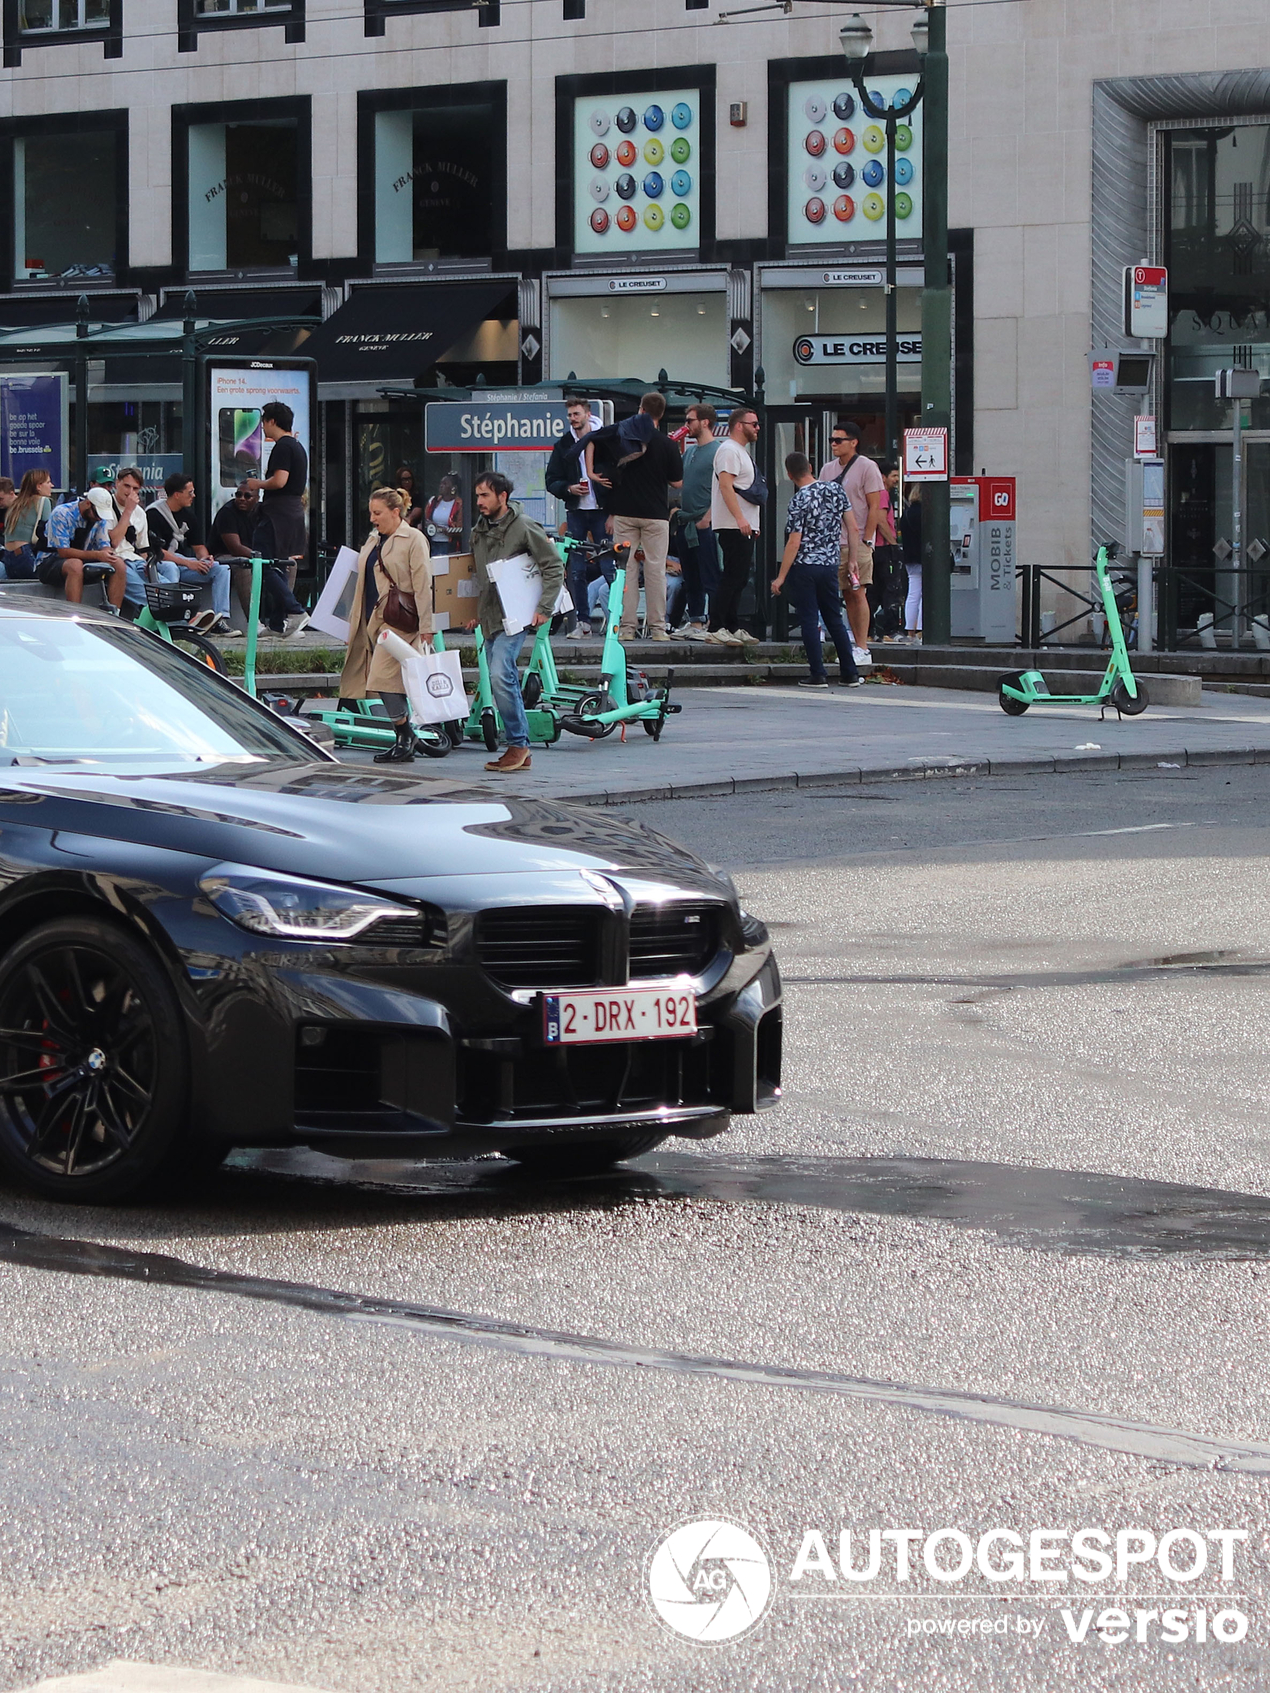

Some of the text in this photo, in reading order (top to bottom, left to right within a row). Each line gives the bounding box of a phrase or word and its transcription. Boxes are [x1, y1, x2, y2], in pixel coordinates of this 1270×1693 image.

[437, 161, 478, 188] MULLER
[843, 273, 877, 281] CREUSET
[618, 280, 662, 289] LE CREUSET
[208, 337, 240, 345] LLER
[335, 332, 433, 344] FRANCK MULLER
[822, 341, 922, 356] LE CRESE
[217, 377, 237, 385] iPhone
[217, 386, 229, 394] Een
[229, 387, 245, 395] grote
[246, 387, 266, 396] sprong
[487, 392, 518, 402] Stéphanie
[522, 392, 548, 402] Stefania
[9, 429, 17, 437] be
[460, 412, 564, 445] Stéphanie
[9, 438, 27, 446] bonne
[993, 492, 1009, 506] GO
[990, 527, 1001, 591] MOBIB
[1002, 526, 1012, 591] & Tickets
[548, 1022, 558, 1037] B
